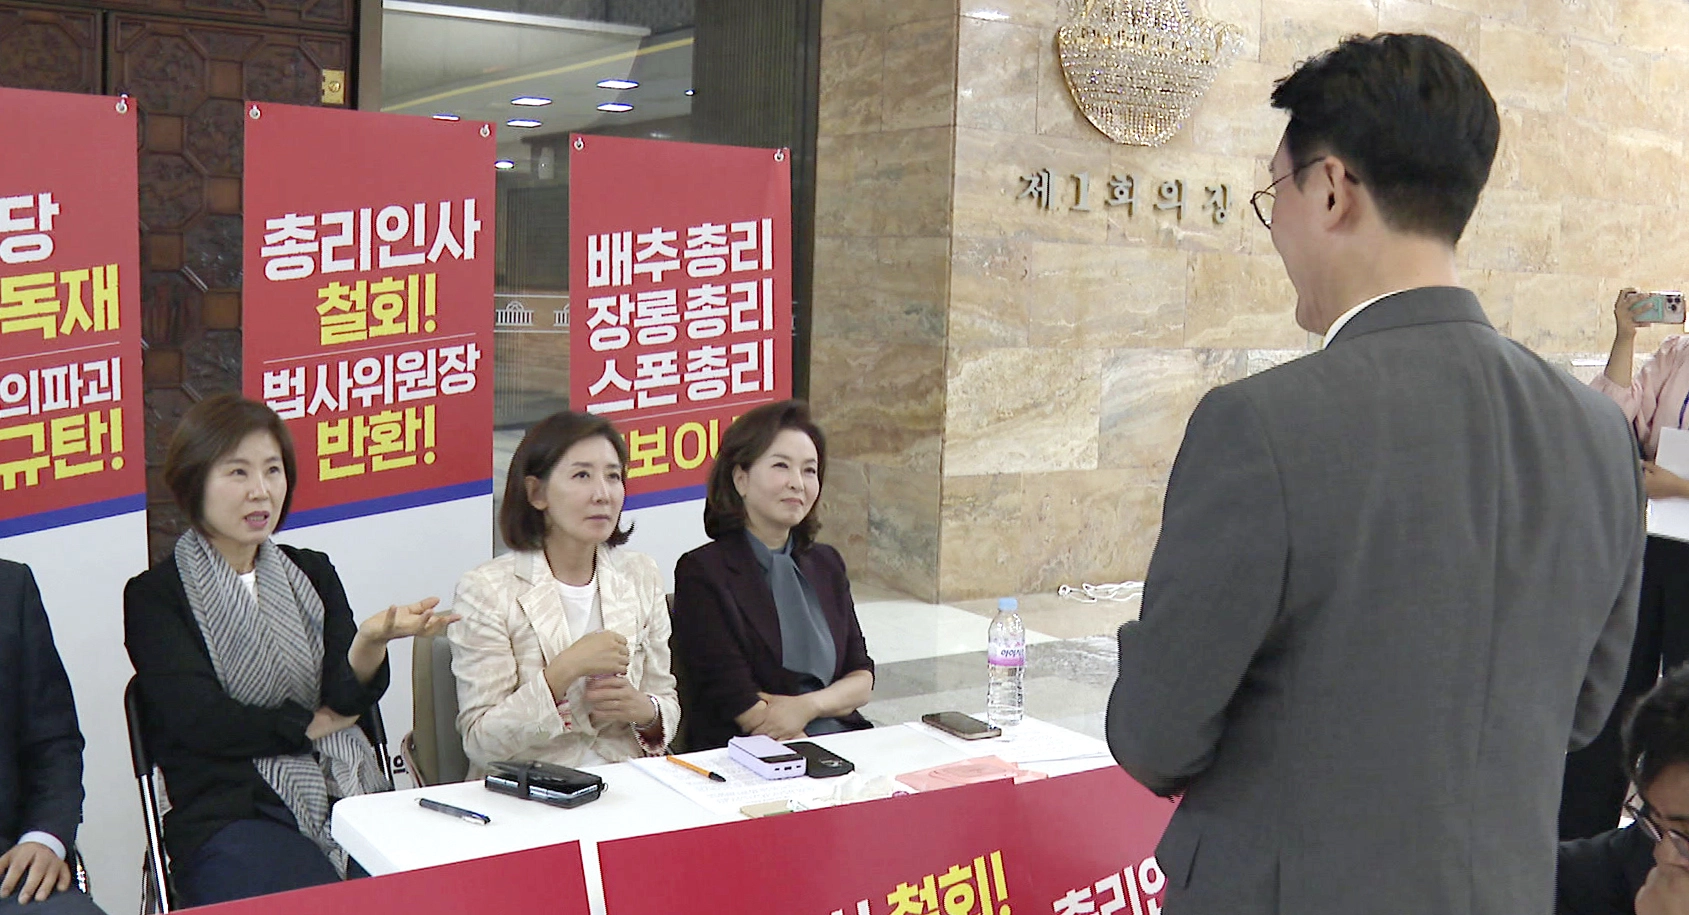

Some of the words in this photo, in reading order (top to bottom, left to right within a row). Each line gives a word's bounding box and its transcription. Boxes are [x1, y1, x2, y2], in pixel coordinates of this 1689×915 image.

[1016, 168, 1234, 224] 제1회의장
[261, 198, 482, 282] 총리인사
[587, 227, 681, 288] 배추
[684, 218, 774, 278] 총리
[0, 263, 120, 340] 독재
[315, 273, 437, 346] 철회!
[586, 288, 681, 352] 장롱
[684, 278, 774, 340] 총리
[263, 343, 481, 421] 법사위원장
[586, 351, 681, 415] 스폰
[684, 338, 775, 402] 총리
[317, 404, 437, 482] 반환!
